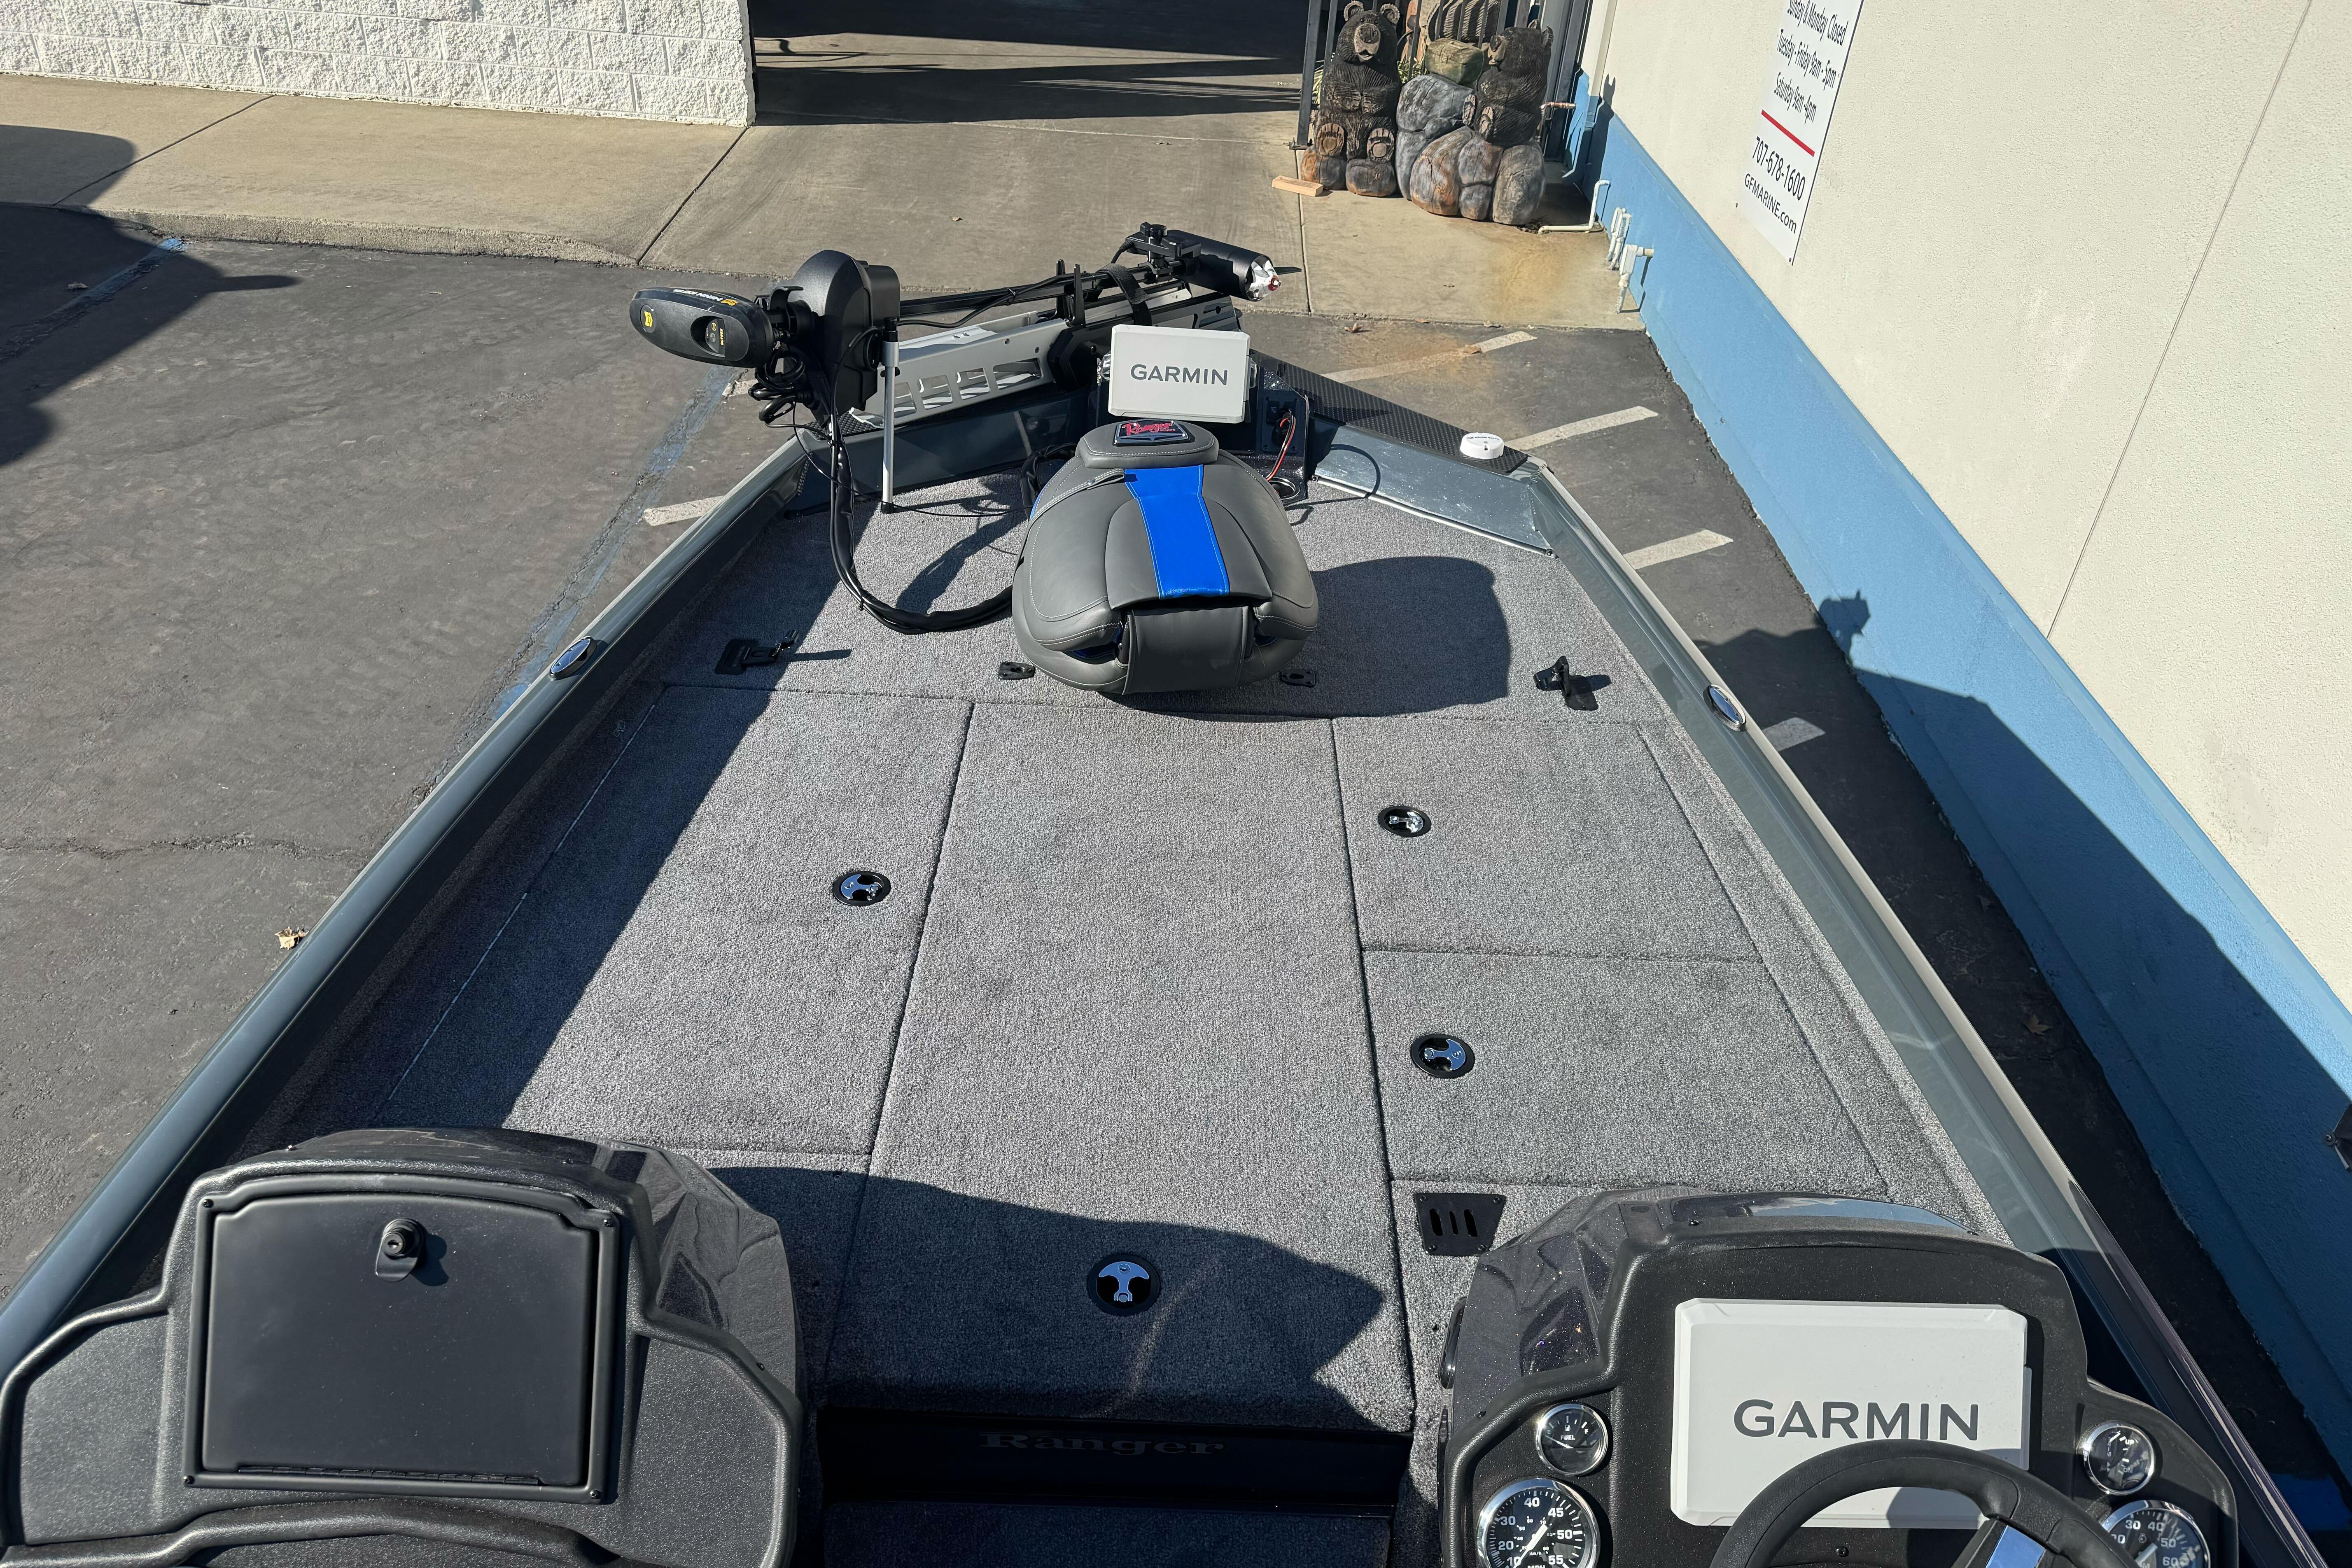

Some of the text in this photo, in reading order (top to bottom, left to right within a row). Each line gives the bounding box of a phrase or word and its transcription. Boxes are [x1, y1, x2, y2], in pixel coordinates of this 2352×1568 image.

[1803, 0, 1810, 24] &
[1806, 2, 1828, 41] Monday
[1827, 14, 1848, 46] Closed
[1777, 29, 1795, 66] Tuesday
[1795, 42, 1812, 77] Friday
[1809, 51, 1822, 79] 9am
[1822, 60, 1836, 91] 5pm
[1774, 72, 1795, 111] Saturday
[1792, 86, 1804, 113] 9am
[1752, 136, 1805, 201] 707-678-1600
[1745, 173, 1797, 234] GFMARINE.com
[1131, 364, 1227, 385] GARMIN
[1734, 1399, 1978, 1440] GARMIN
[979, 1432, 1224, 1456] Ranger
[1524, 1497, 1540, 1507] 40
[1548, 1507, 1563, 1517] 45
[1500, 1516, 1516, 1525] 30
[2126, 1520, 2141, 1530] 30
[2148, 1522, 2163, 1531] 40
[1557, 1530, 1573, 1539] 50
[1498, 1541, 1514, 1550] 20
[2161, 1538, 2176, 1547] 50
[1507, 1557, 1521, 1566] 10
[1548, 1555, 1563, 1565] 55
[2163, 1556, 2178, 1566] 60
